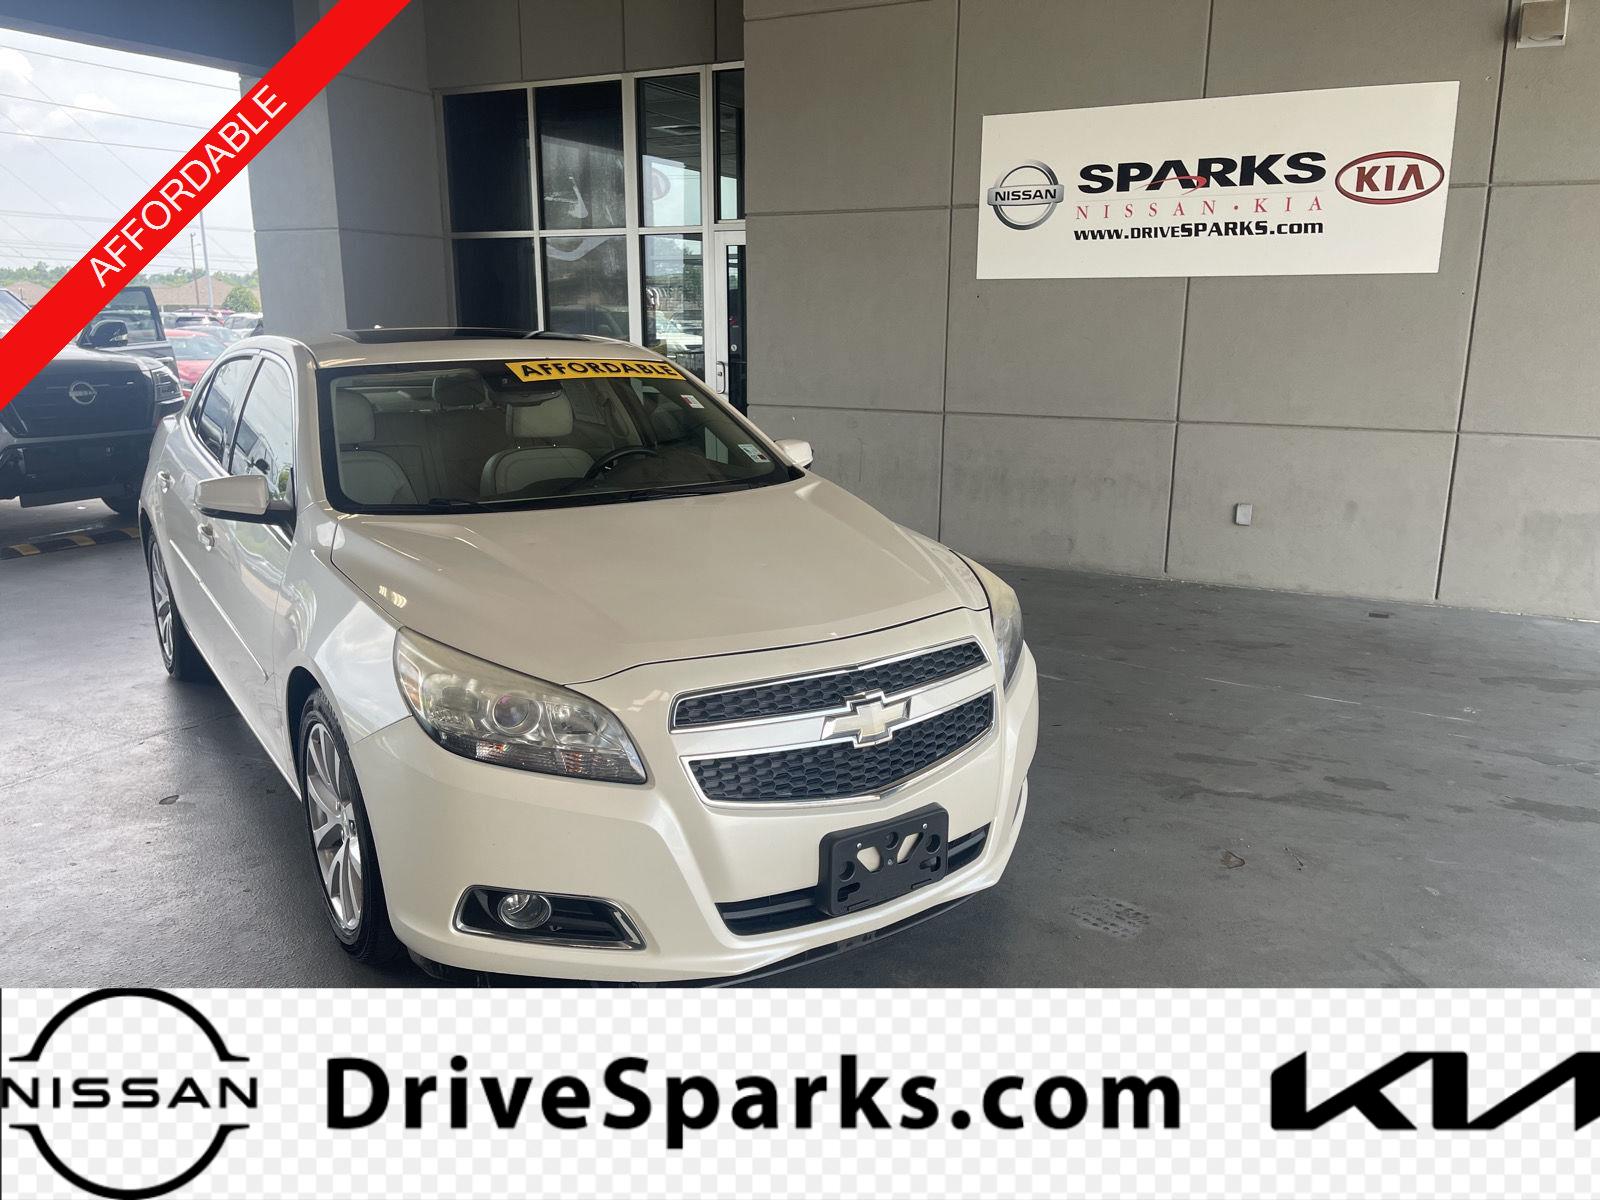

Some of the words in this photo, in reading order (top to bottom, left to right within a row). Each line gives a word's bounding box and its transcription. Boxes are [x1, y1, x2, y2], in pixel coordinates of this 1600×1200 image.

[1078, 151, 1327, 194] SPARKS
[1355, 163, 1425, 193] KIA
[994, 187, 1057, 203] NISSAN
[1076, 201, 1216, 220] NISSAN
[1254, 196, 1323, 213] KIA
[521, 361, 678, 377] AFFORDABLE
